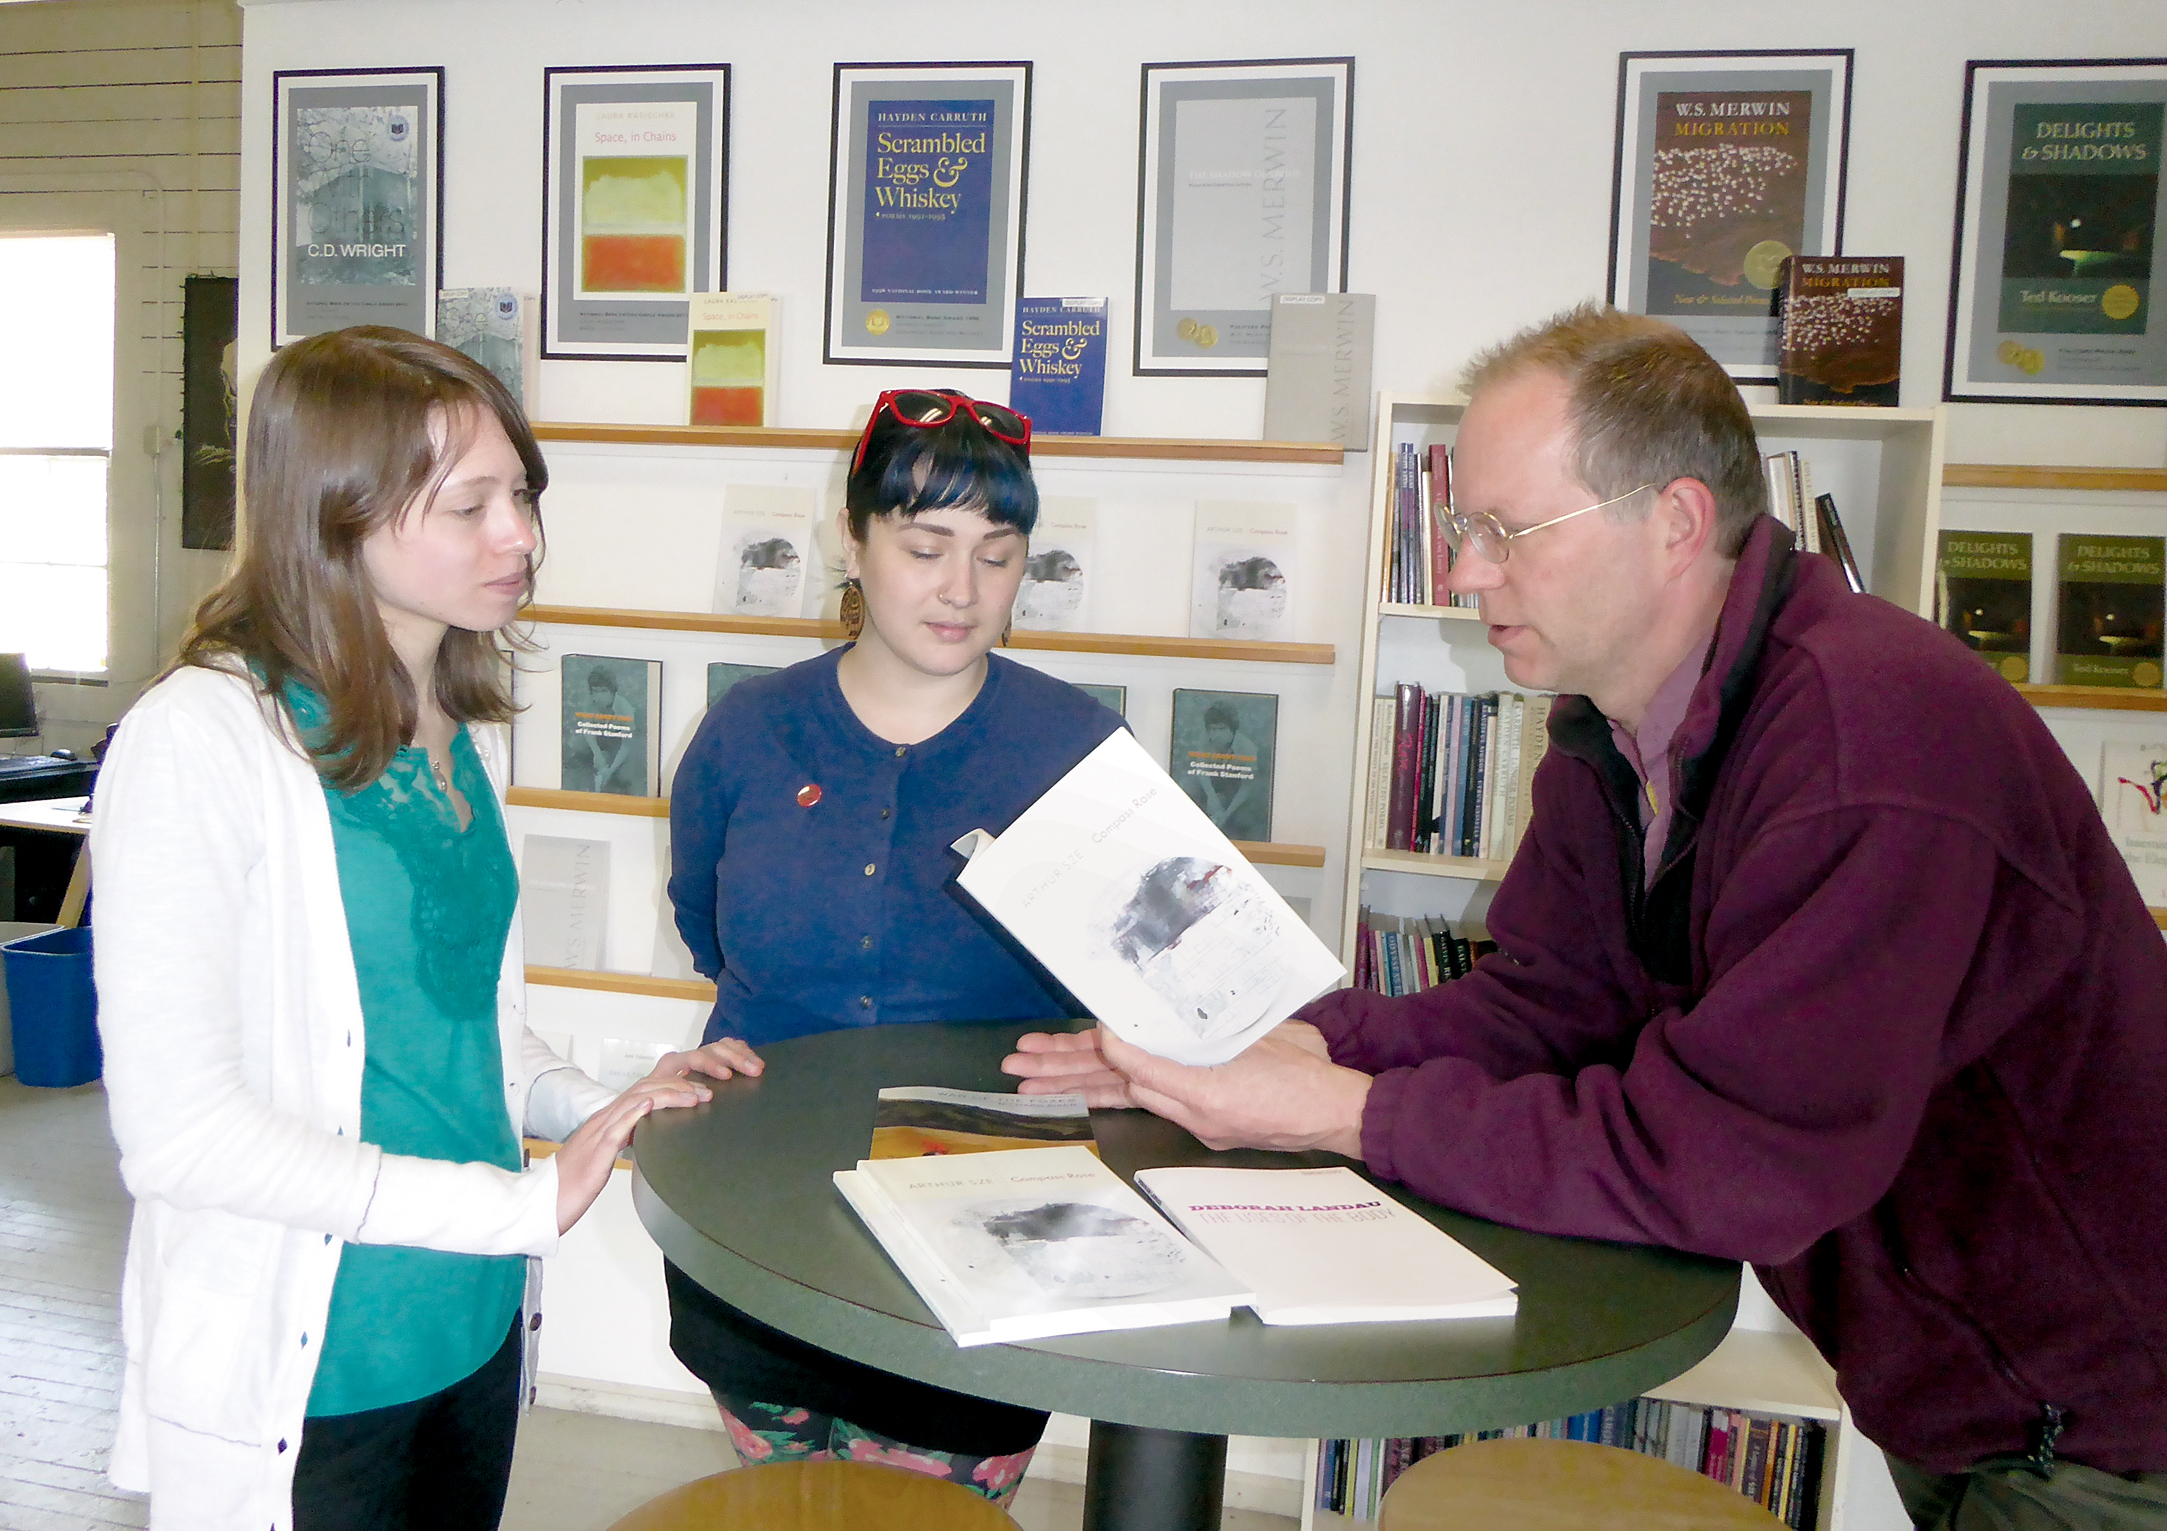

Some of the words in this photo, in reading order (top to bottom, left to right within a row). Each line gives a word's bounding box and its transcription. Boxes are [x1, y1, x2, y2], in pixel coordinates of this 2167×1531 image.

[598, 111, 624, 120] LAURA
[878, 112, 926, 121] HAYDEN
[930, 112, 987, 122] CARRUTH
[1675, 102, 1706, 117] W.S.
[1709, 101, 1790, 116] MERWIN
[1675, 122, 1790, 136] MIGRATION
[2036, 122, 2135, 139] DELIGHTS
[595, 132, 627, 144] Space,
[631, 131, 640, 142] in
[643, 131, 677, 142] Chains
[877, 131, 986, 153] Scrambled
[2041, 143, 2148, 161] SHADOWS
[877, 157, 929, 185] Eggs
[933, 157, 968, 188] &
[1209, 170, 1252, 179] SHADOW
[1262, 109, 1288, 239] MERWIN
[875, 187, 962, 215] Whiskey
[308, 244, 338, 257] C.D.
[340, 244, 406, 258] WRIGHT
[1801, 263, 1824, 274] W.S.
[1828, 263, 1890, 274] MERWIN
[1802, 277, 1890, 288] MIGRATION
[2019, 289, 2046, 302] Ted
[703, 312, 727, 321] Space,
[737, 312, 759, 320] Chains
[1022, 319, 1100, 336] Scrambled
[1021, 338, 1060, 358] Eggs
[1061, 337, 1088, 360] &
[1332, 300, 1355, 397] MERWIN
[1019, 358, 1082, 379] Whiskey
[1948, 541, 2019, 555] DELIGHTS
[2077, 545, 2151, 559] DELIGHTS
[1950, 557, 2028, 571] SHADOWS
[2080, 561, 2161, 575] SHADOWS
[577, 721, 608, 729] Collected
[608, 723, 631, 731] Poems
[583, 728, 603, 736] Frank
[603, 730, 633, 738] Stanford
[1512, 705, 1523, 750] CARRUTH
[1534, 707, 1546, 761] HAYDEN
[1190, 761, 1226, 770] Collected
[1226, 763, 1252, 772] Poems
[1196, 769, 1219, 777] Frank
[1220, 771, 1255, 780] Stanford
[1498, 750, 1509, 797] CARRUTH
[1380, 762, 1390, 801] SELECTED
[1508, 757, 1520, 796] LONGER
[1378, 802, 1388, 830] POEMS
[1506, 796, 1516, 827] POEMS
[1022, 868, 1063, 909] ARTHUR
[1062, 849, 1084, 870] SZE
[1091, 807, 1135, 843] Compass
[1132, 787, 1157, 808] Rose
[568, 844, 591, 930] MERWIN
[909, 1181, 964, 1189] ARTHUR
[1010, 1174, 1065, 1183] Compass
[1188, 1204, 1294, 1212] DEBORAH
[1299, 1201, 1382, 1212] LANDAU
[1199, 1212, 1233, 1225] THE
[1236, 1213, 1286, 1225] USES
[1291, 1212, 1308, 1224] OF
[1312, 1213, 1345, 1224] THE
[1347, 1208, 1396, 1223] BODY
